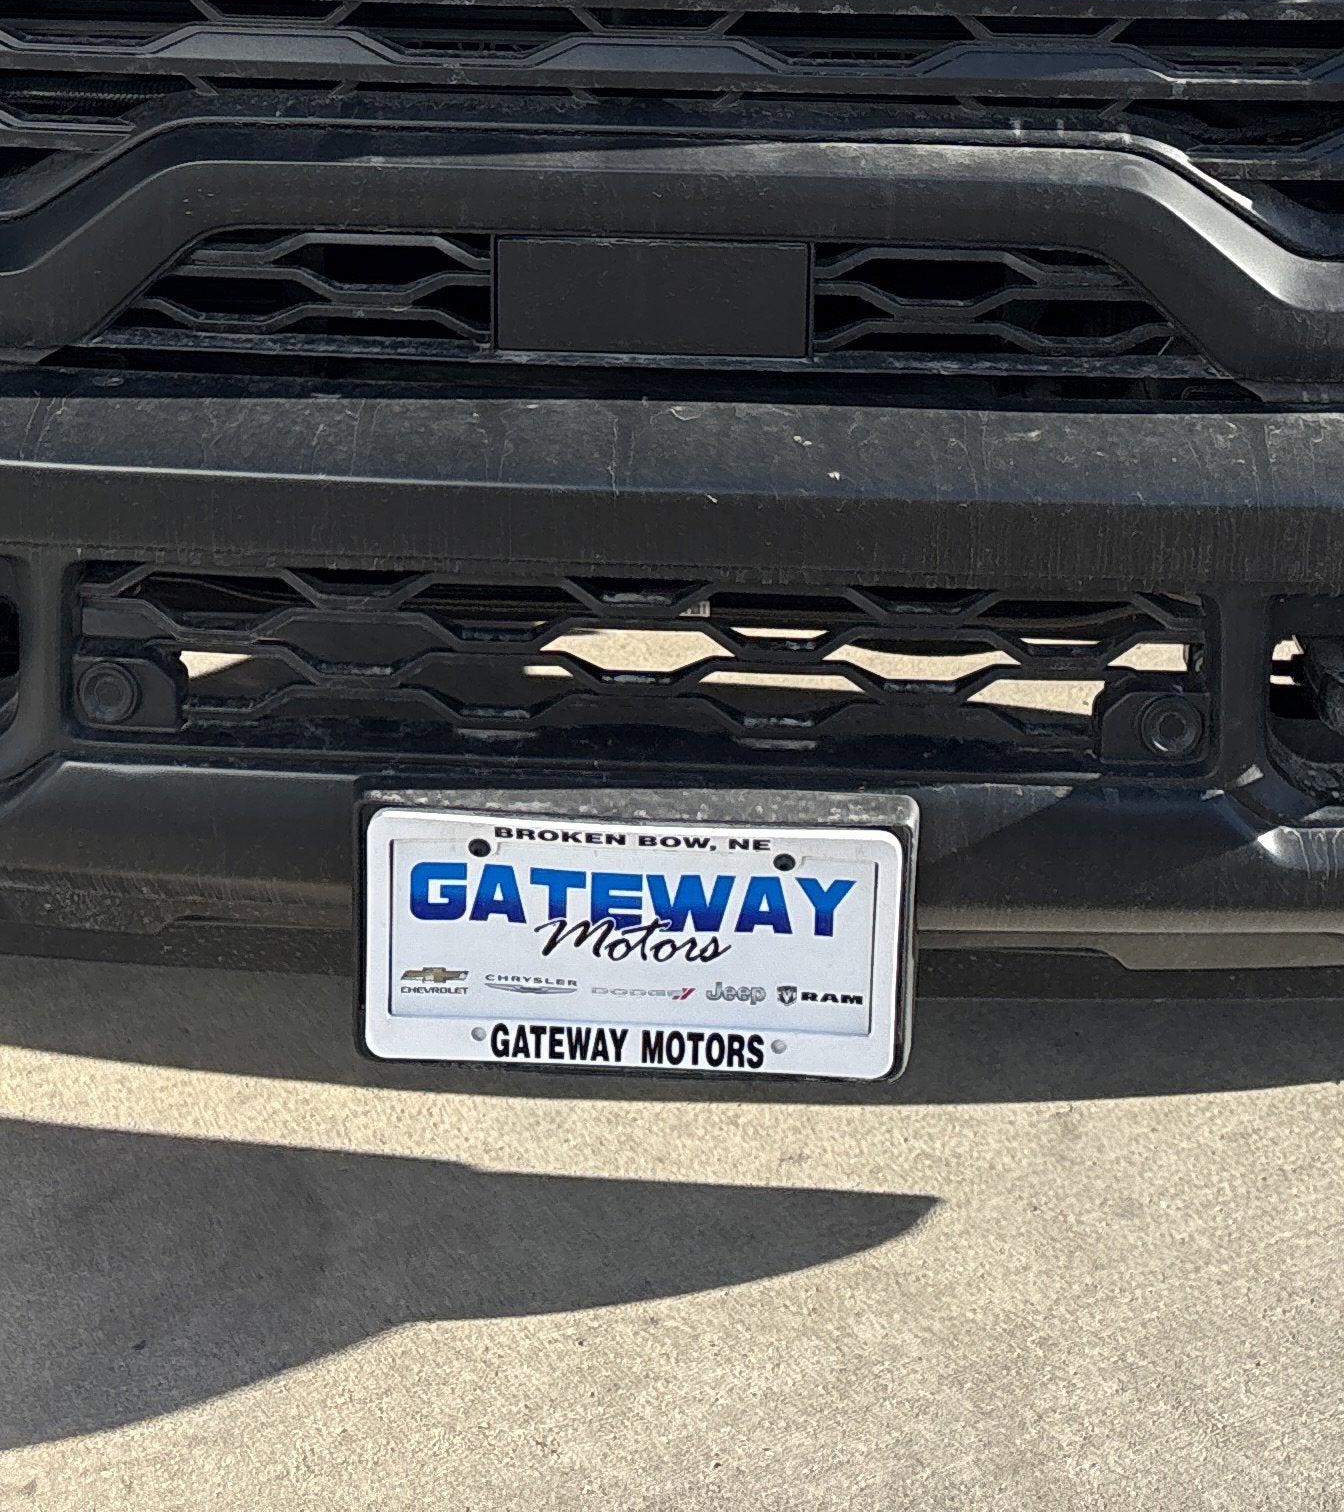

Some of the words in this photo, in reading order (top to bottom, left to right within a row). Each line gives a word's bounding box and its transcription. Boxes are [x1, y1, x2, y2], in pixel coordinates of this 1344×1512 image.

[494, 826, 627, 847] BROKEN
[638, 836, 718, 852] BOW,
[728, 838, 772, 852] NE
[409, 861, 857, 938] GATEWAY
[533, 918, 733, 964] Motors
[400, 986, 469, 996] CHEVROLET
[484, 973, 579, 988] CHRYSLER
[705, 981, 767, 1006] Jeep
[800, 991, 864, 1006] RAM
[489, 1023, 630, 1064] GATEWAY
[640, 1029, 766, 1071] MOTORS
